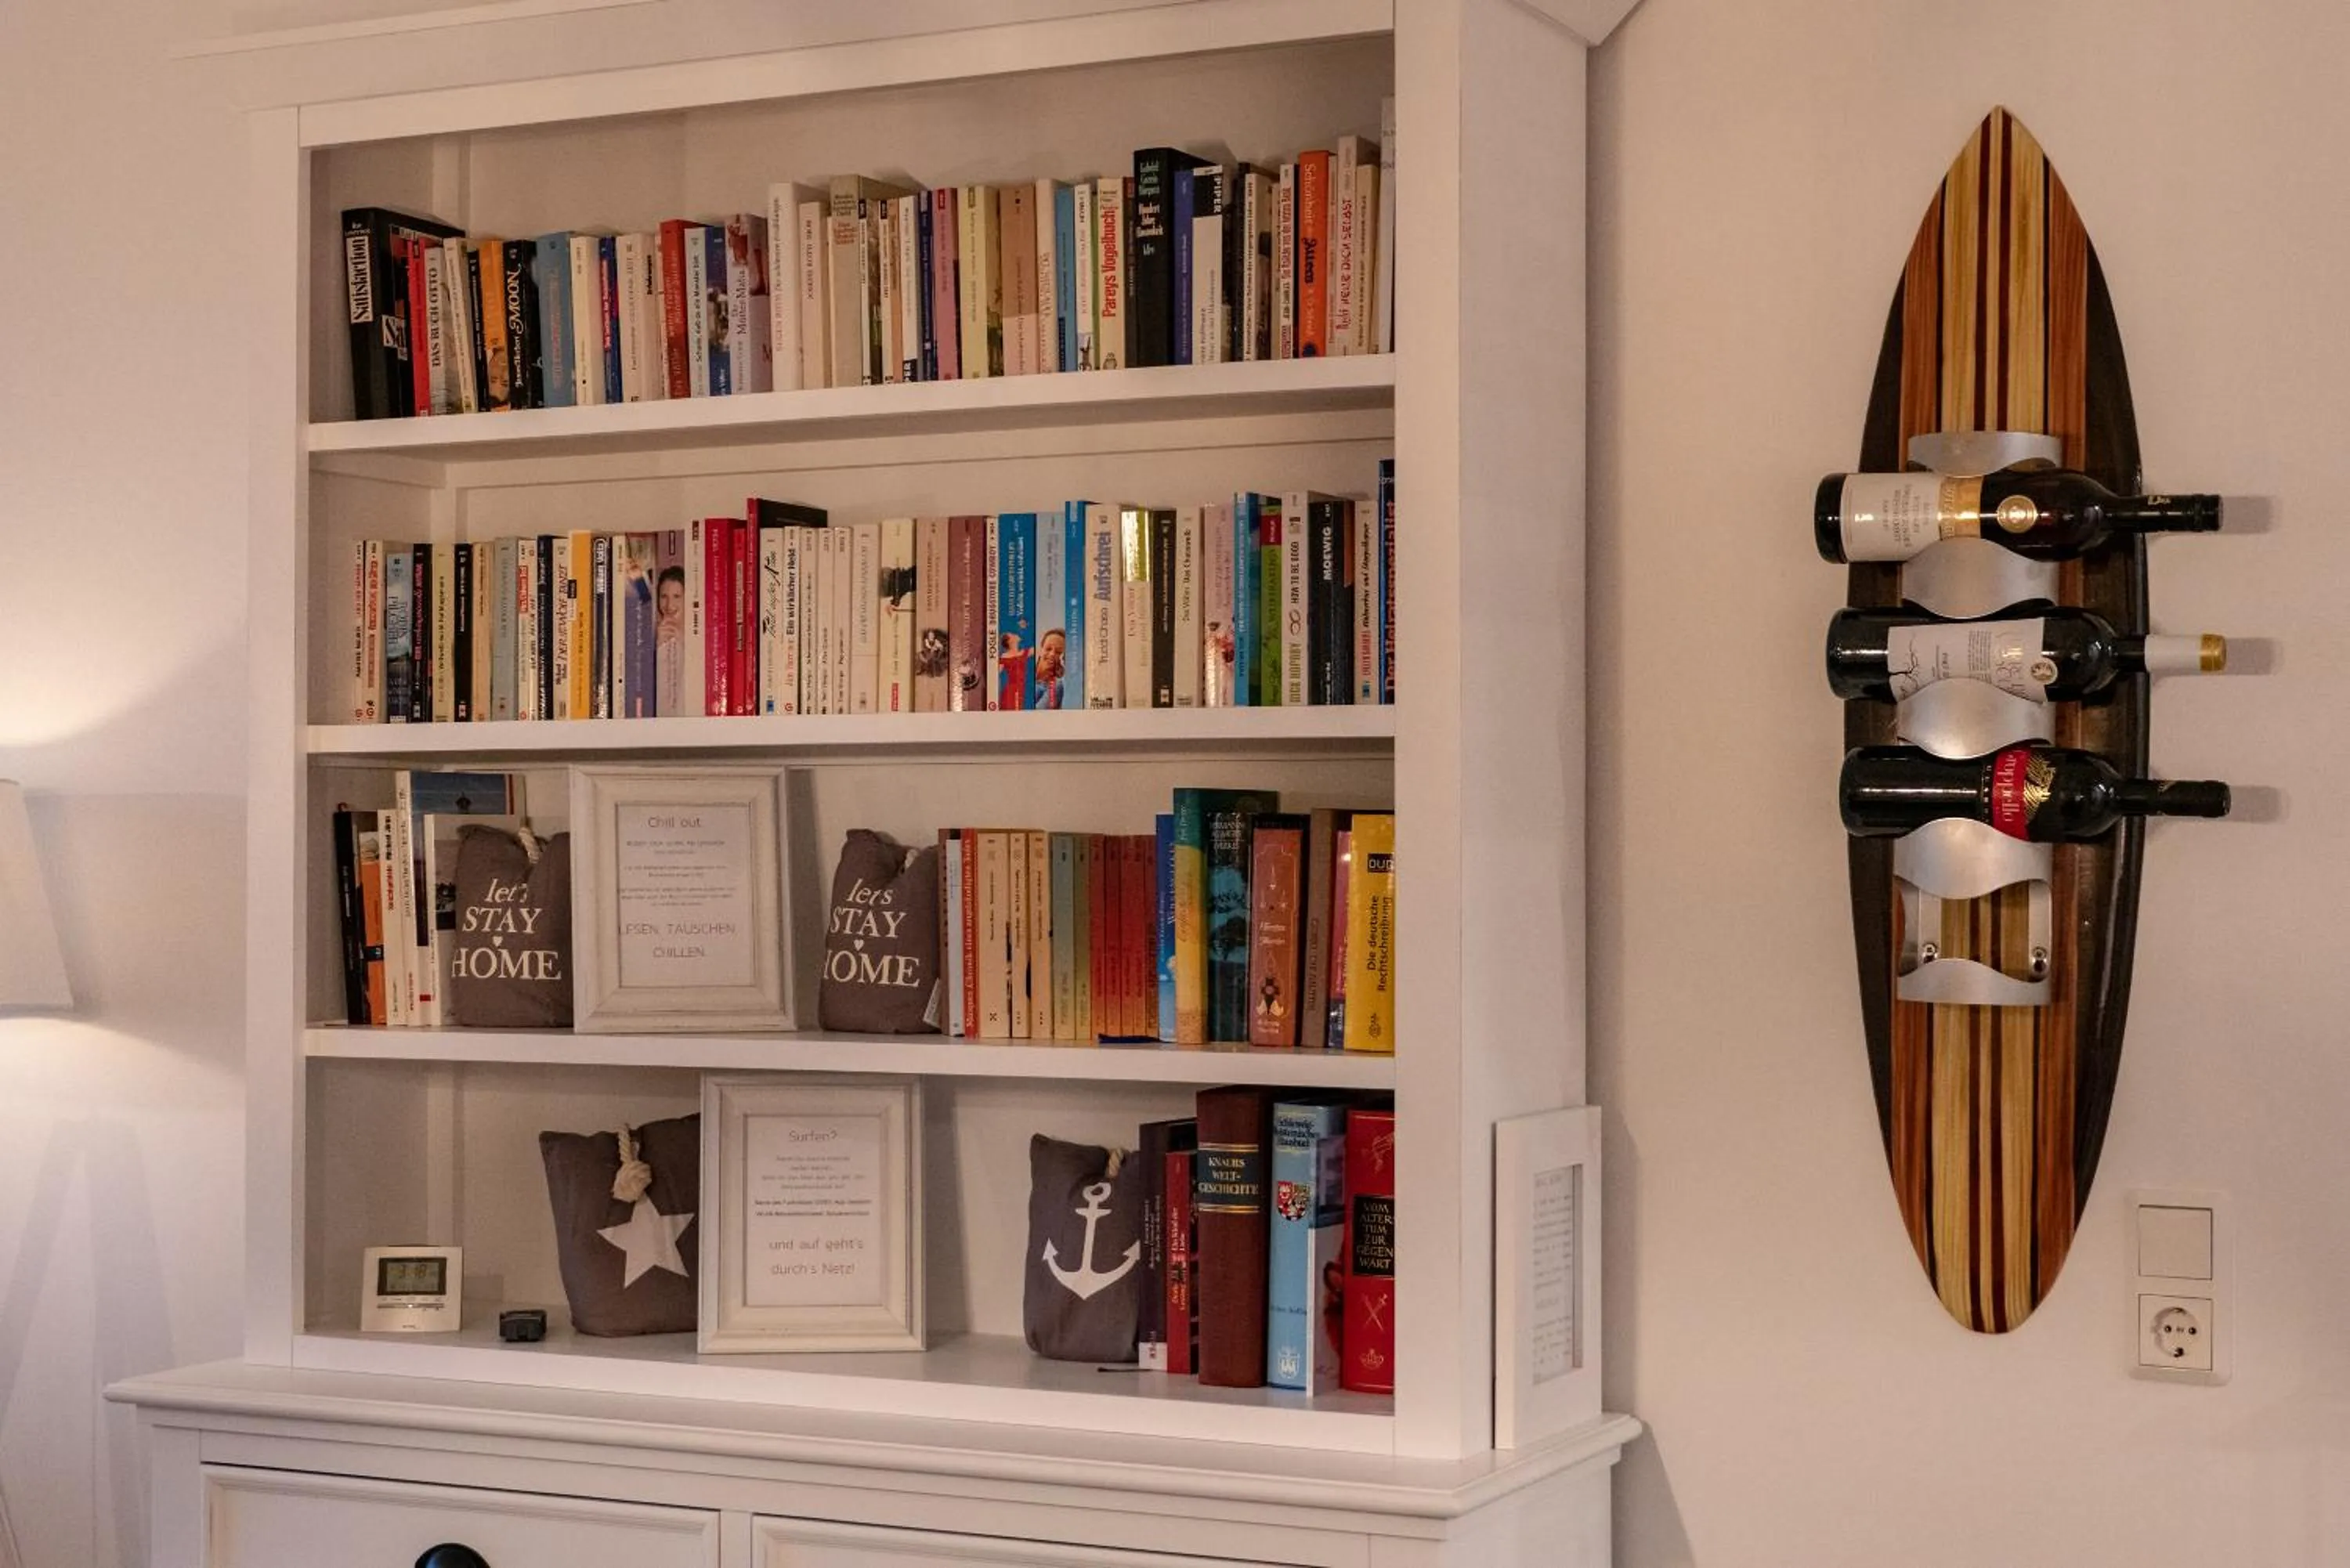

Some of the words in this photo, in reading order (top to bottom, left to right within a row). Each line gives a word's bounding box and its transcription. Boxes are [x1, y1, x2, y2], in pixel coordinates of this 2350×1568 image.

[1341, 199, 1352, 240] SELBST
[1100, 209, 1118, 272] Vogelbuch
[1340, 243, 1351, 271] DICH
[349, 237, 371, 321] Satisfaction
[428, 267, 439, 304] OTTO
[507, 264, 523, 334] MOON
[1101, 274, 1119, 318] Pareys
[428, 306, 440, 340] BUCH
[429, 342, 441, 367] DAS
[1093, 532, 1112, 602] Aufschrei
[1322, 526, 1332, 580] MOEWIG
[786, 572, 796, 618] wirklicher
[786, 620, 795, 635] Ein
[648, 816, 675, 828] Chill
[680, 818, 701, 828] out
[462, 906, 543, 934] STAY
[830, 905, 908, 938] STAY
[1367, 895, 1379, 948] deutsche
[451, 946, 562, 981] HOME
[1365, 952, 1376, 971] Die
[1209, 1156, 1246, 1168] KNAURS
[1198, 1183, 1259, 1194] GESCHICHTE
[1363, 1202, 1389, 1213] VOM
[769, 1239, 794, 1250] und
[799, 1237, 820, 1250] auf
[1365, 1225, 1387, 1235] TUM
[1365, 1235, 1386, 1245] ZUR
[1359, 1258, 1391, 1270] WART
